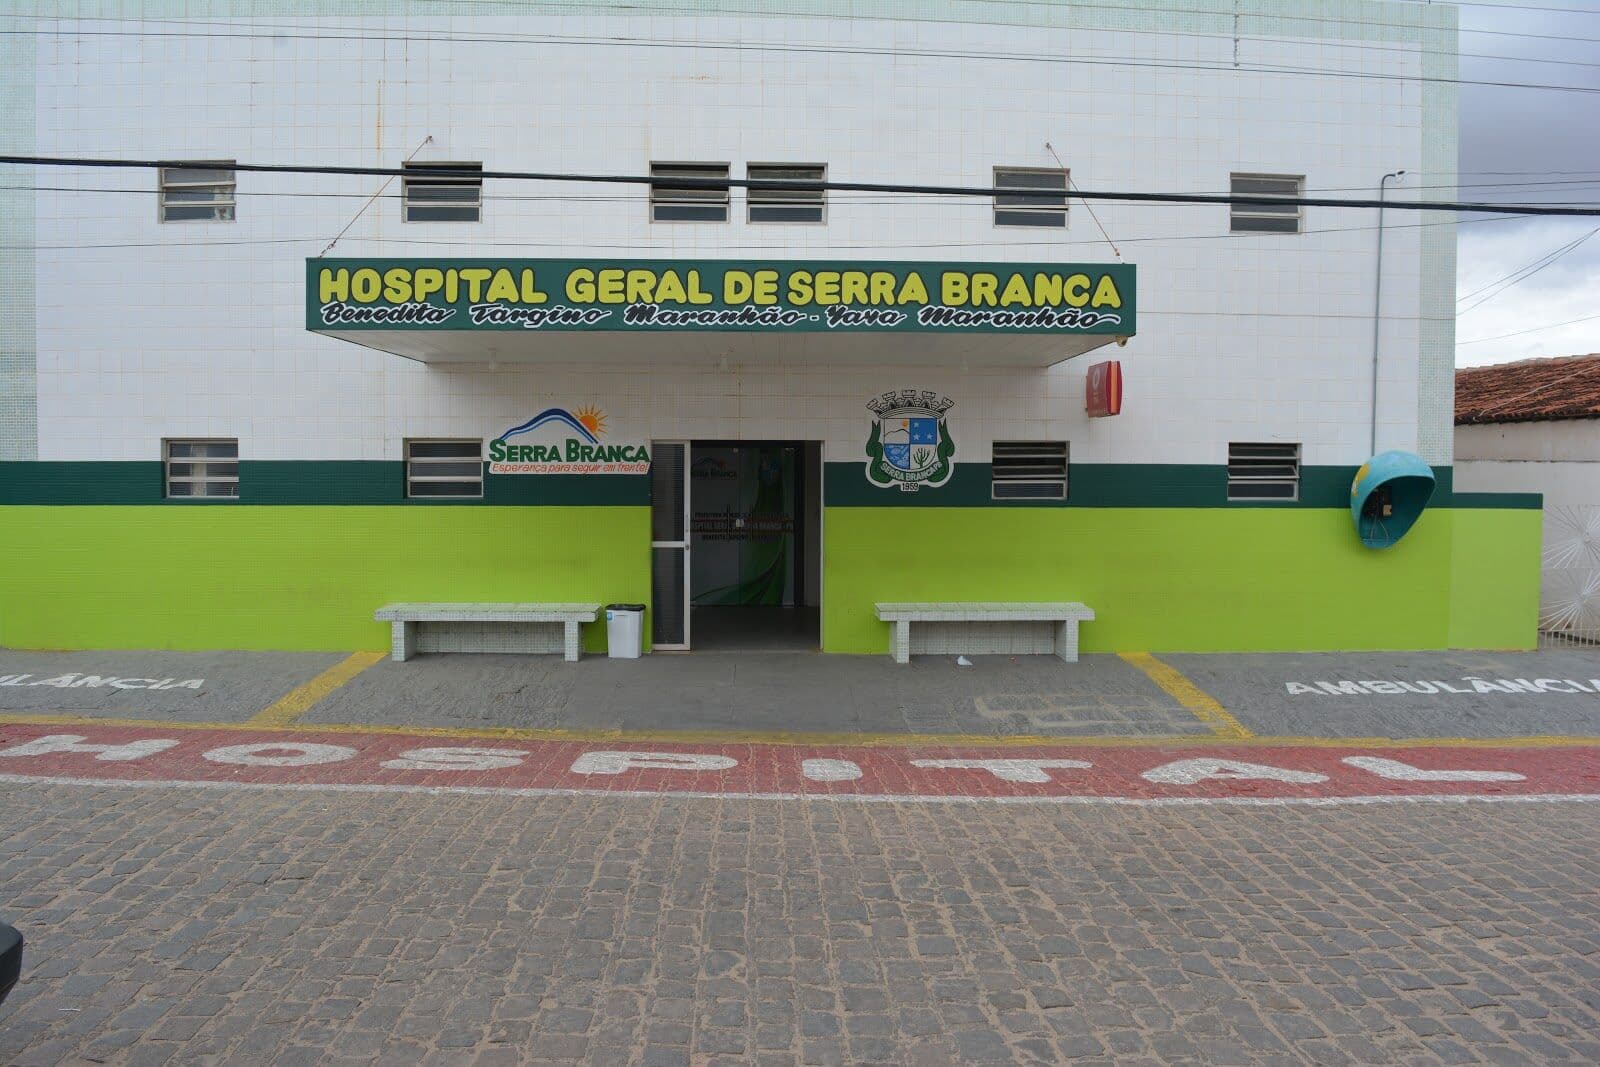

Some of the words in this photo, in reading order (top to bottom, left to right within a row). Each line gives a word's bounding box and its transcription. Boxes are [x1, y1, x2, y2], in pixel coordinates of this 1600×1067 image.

[319, 268, 547, 304] HOSPITAL
[566, 268, 712, 304] GERAL
[723, 270, 779, 305] DE
[788, 271, 928, 305] SERRA
[941, 272, 1121, 308] BRANCA
[321, 301, 456, 325] Benedita
[469, 303, 611, 329] Targino
[624, 303, 805, 325] Maranhão
[917, 305, 1121, 328] Maranhão
[489, 438, 562, 462] SERRA
[565, 438, 650, 462] BRANCA
[548, 463, 570, 474] para
[880, 462, 904, 480] SERRA
[0, 734, 1527, 785] HOSPITAL
